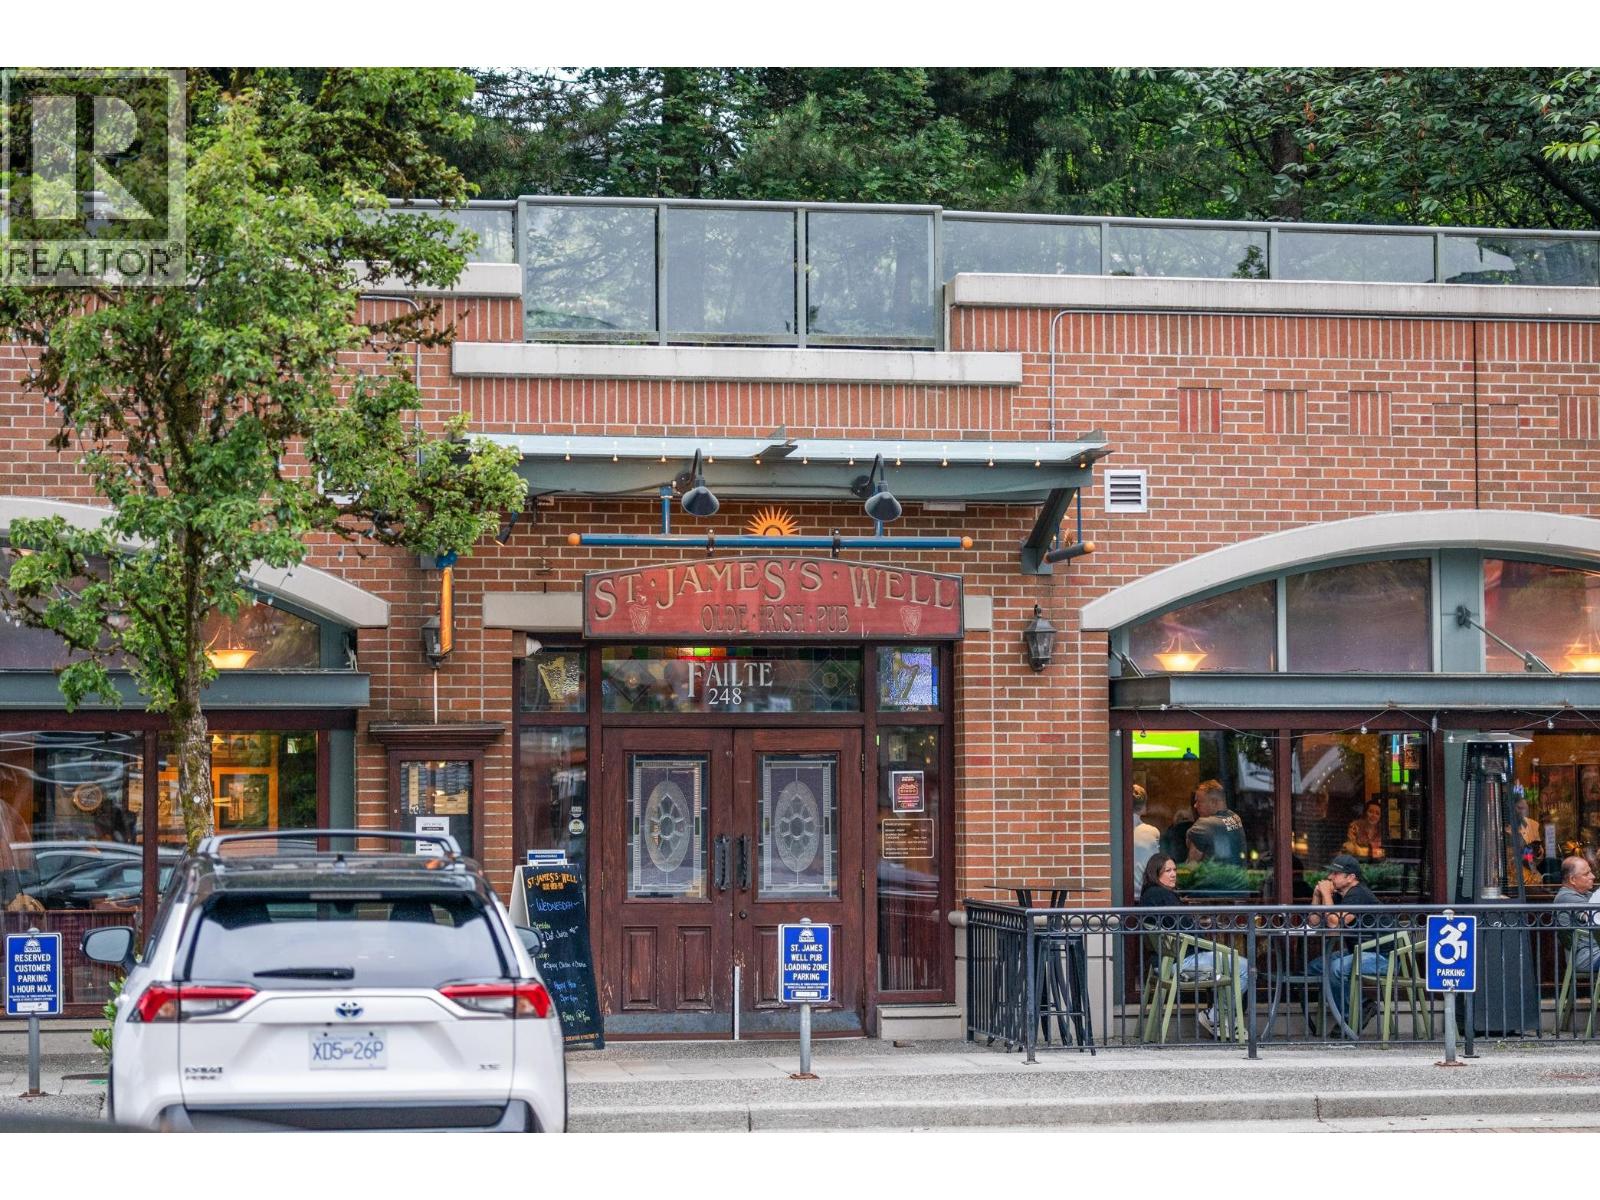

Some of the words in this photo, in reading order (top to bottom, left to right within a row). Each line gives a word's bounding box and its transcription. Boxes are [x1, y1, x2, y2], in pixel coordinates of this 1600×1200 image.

[656, 560, 823, 609] JAMES'S
[849, 565, 956, 610] WELL
[702, 604, 748, 633] OLDE
[760, 604, 806, 633] IRISH
[817, 604, 850, 633] PUB
[687, 661, 774, 698] FAILTE
[708, 687, 743, 706] 248
[560, 873, 578, 884] WELL
[790, 944, 800, 952] ST.
[802, 944, 823, 952] JAMES
[14, 954, 51, 962] RESERVED
[14, 964, 51, 973] CUSTOMER
[784, 963, 811, 971] LOADING
[812, 963, 829, 971] ZONE
[793, 973, 820, 981] PARKING
[1436, 968, 1465, 977] PARKING
[17, 974, 48, 983] PARKING
[1442, 979, 1460, 987] ONLY
[17, 984, 36, 993] HOUR
[37, 984, 54, 993] MAX.
